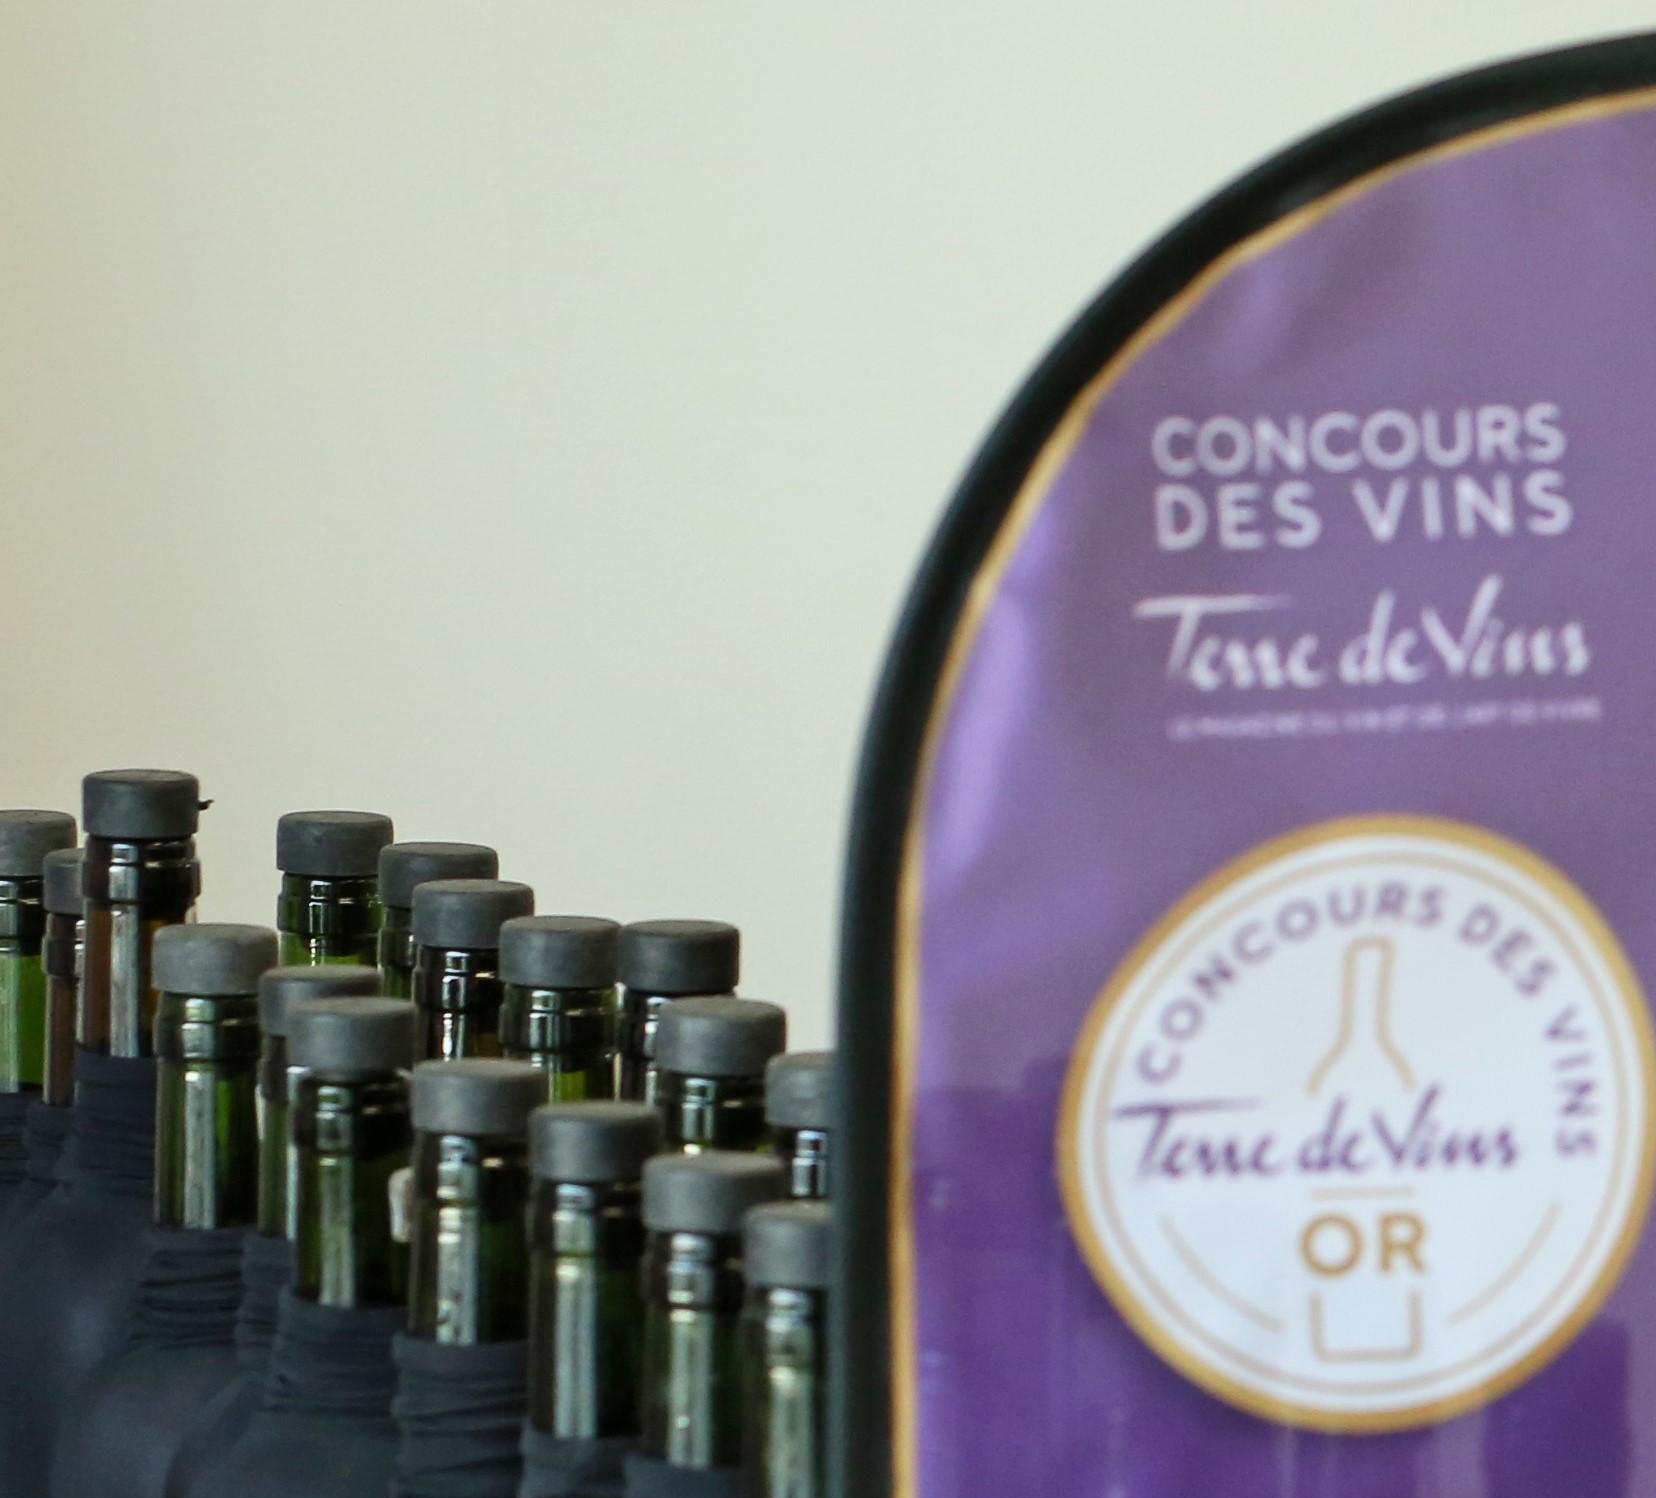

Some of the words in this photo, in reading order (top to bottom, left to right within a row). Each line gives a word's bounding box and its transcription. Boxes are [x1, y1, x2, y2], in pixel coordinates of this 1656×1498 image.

[1151, 402, 1568, 477] CONCOURS
[1154, 480, 1322, 551] DES
[1352, 469, 1574, 542] VINS
[1136, 880, 1446, 1086] CONCOURS
[1456, 902, 1558, 999] DES
[1544, 1004, 1600, 1159] VINS
[1300, 1210, 1427, 1279] OR
